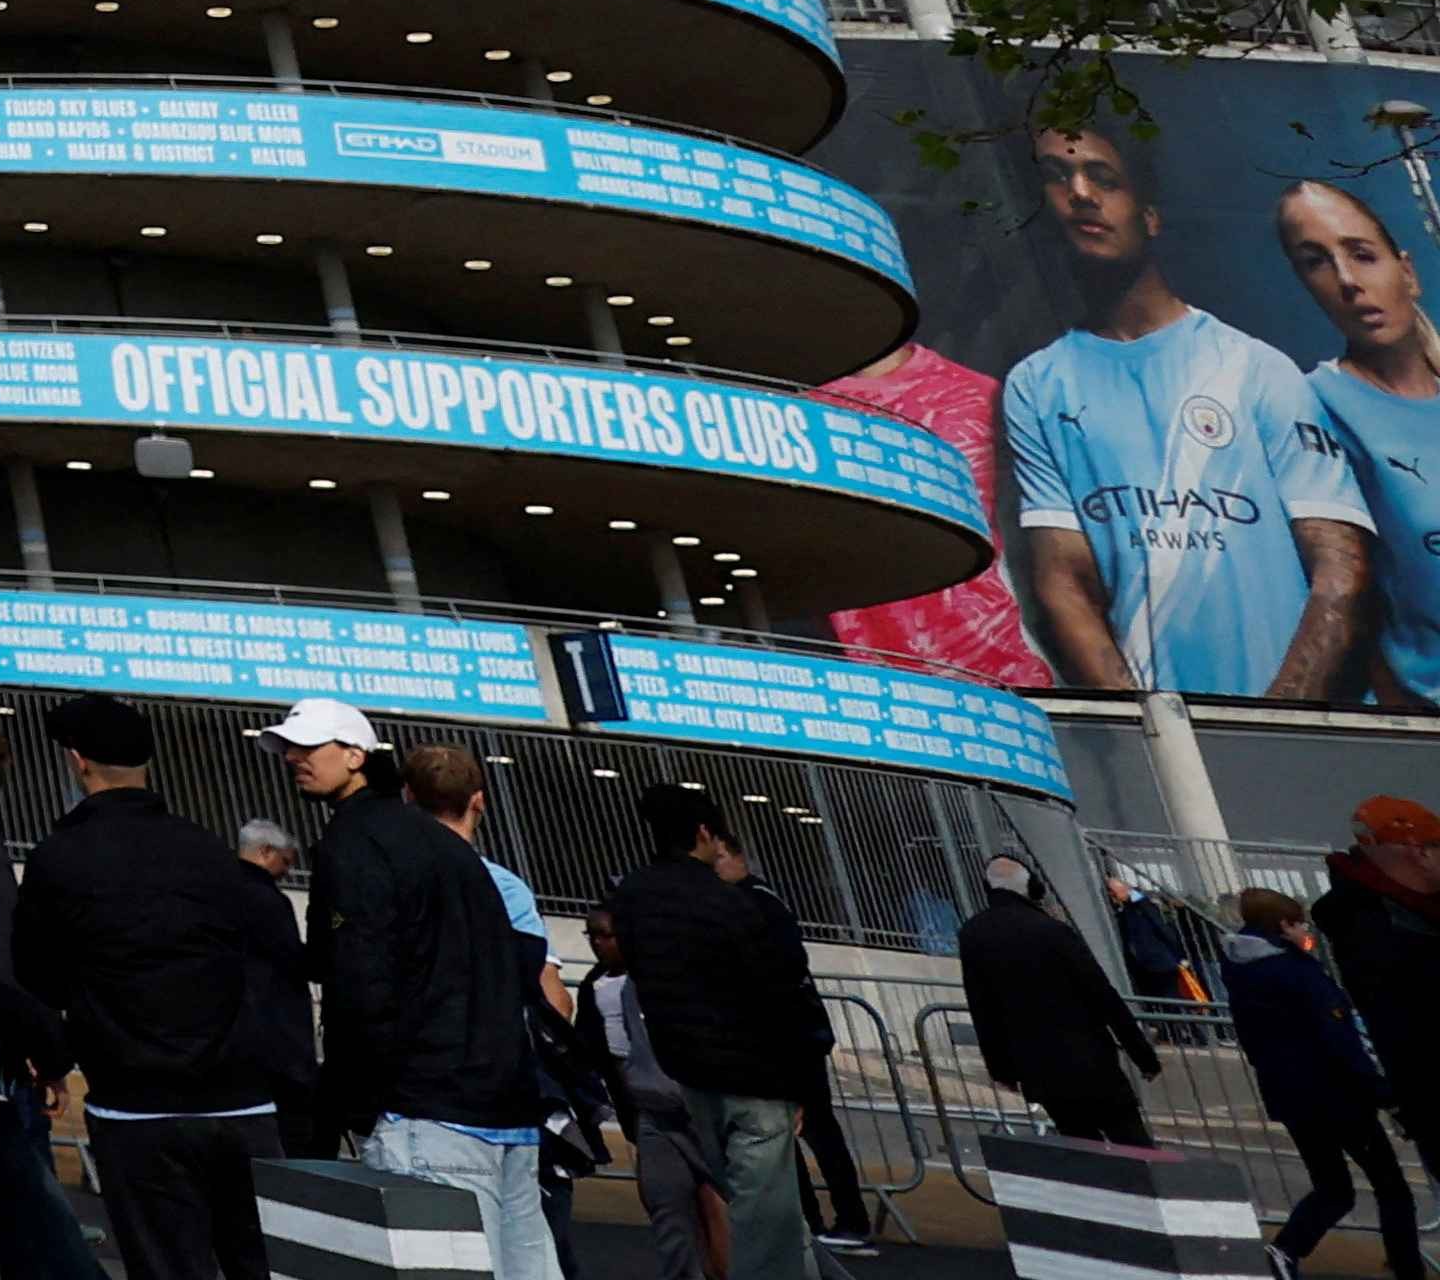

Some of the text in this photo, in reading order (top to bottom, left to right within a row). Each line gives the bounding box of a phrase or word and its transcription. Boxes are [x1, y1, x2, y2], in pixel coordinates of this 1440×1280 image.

[60, 100, 88, 116] SKY
[91, 99, 137, 117] BLUES
[159, 100, 219, 120] GALWAY
[7, 121, 55, 139] GRAND
[58, 121, 112, 139] RAPIDS
[219, 124, 256, 143] BLUE
[258, 125, 303, 145] MOON
[345, 132, 534, 161] ETIHAD STADIUM
[68, 143, 127, 161] HALIFAX
[150, 144, 215, 164] DISTRICT
[9, 341, 76, 361] CITYZENS
[33, 364, 79, 384] MOON
[110, 342, 354, 425] OFFICIAL
[356, 356, 684, 459] SUPPORTERS
[683, 389, 818, 473] CLUBS
[1083, 484, 1261, 525] ETIHAD
[13, 601, 517, 654] CITY SKY BLUES RUSHOLME MOSS SAINT LOUIS
[189, 635, 230, 659] WEST
[236, 639, 288, 663] LANCS
[306, 644, 411, 672] STALYBRIDGE
[412, 651, 460, 676] BLUES
[13, 651, 457, 701] VANCOUVER WARRINGTON WARWICK LEAMINGTON
[563, 640, 596, 714] T
[658, 701, 787, 736] CAPITAL CITY BLUES
